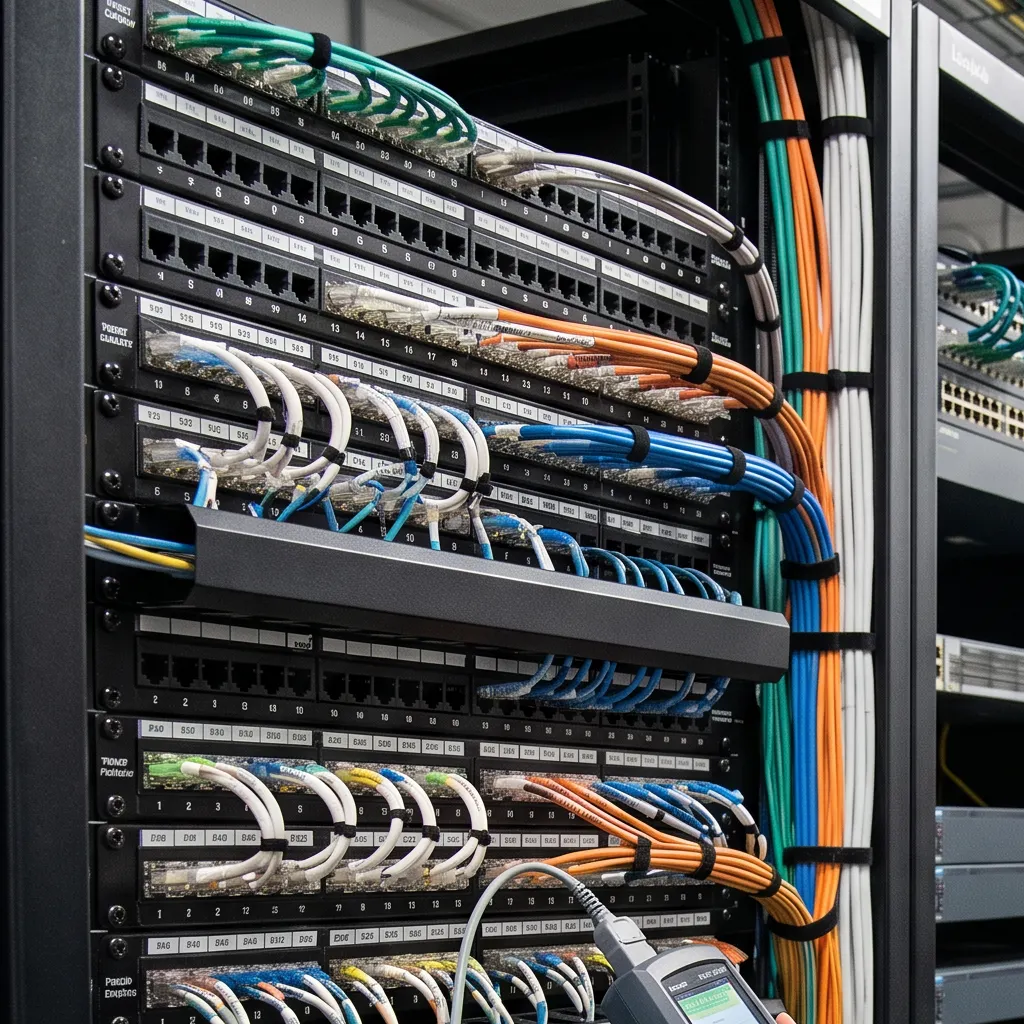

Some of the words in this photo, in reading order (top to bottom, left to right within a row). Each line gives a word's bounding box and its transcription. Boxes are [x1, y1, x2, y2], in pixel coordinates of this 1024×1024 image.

[330, 323, 340, 333] 13
[355, 330, 365, 340] 14
[381, 338, 390, 348] 15
[427, 351, 436, 361] 17
[154, 486, 161, 496] 6
[153, 695, 158, 704] 2
[182, 697, 188, 707] 2
[157, 801, 161, 810] 1
[186, 801, 192, 811] 2
[215, 802, 221, 811] 3
[157, 909, 162, 919] 1
[215, 907, 221, 917] 2
[242, 906, 250, 915] 12
